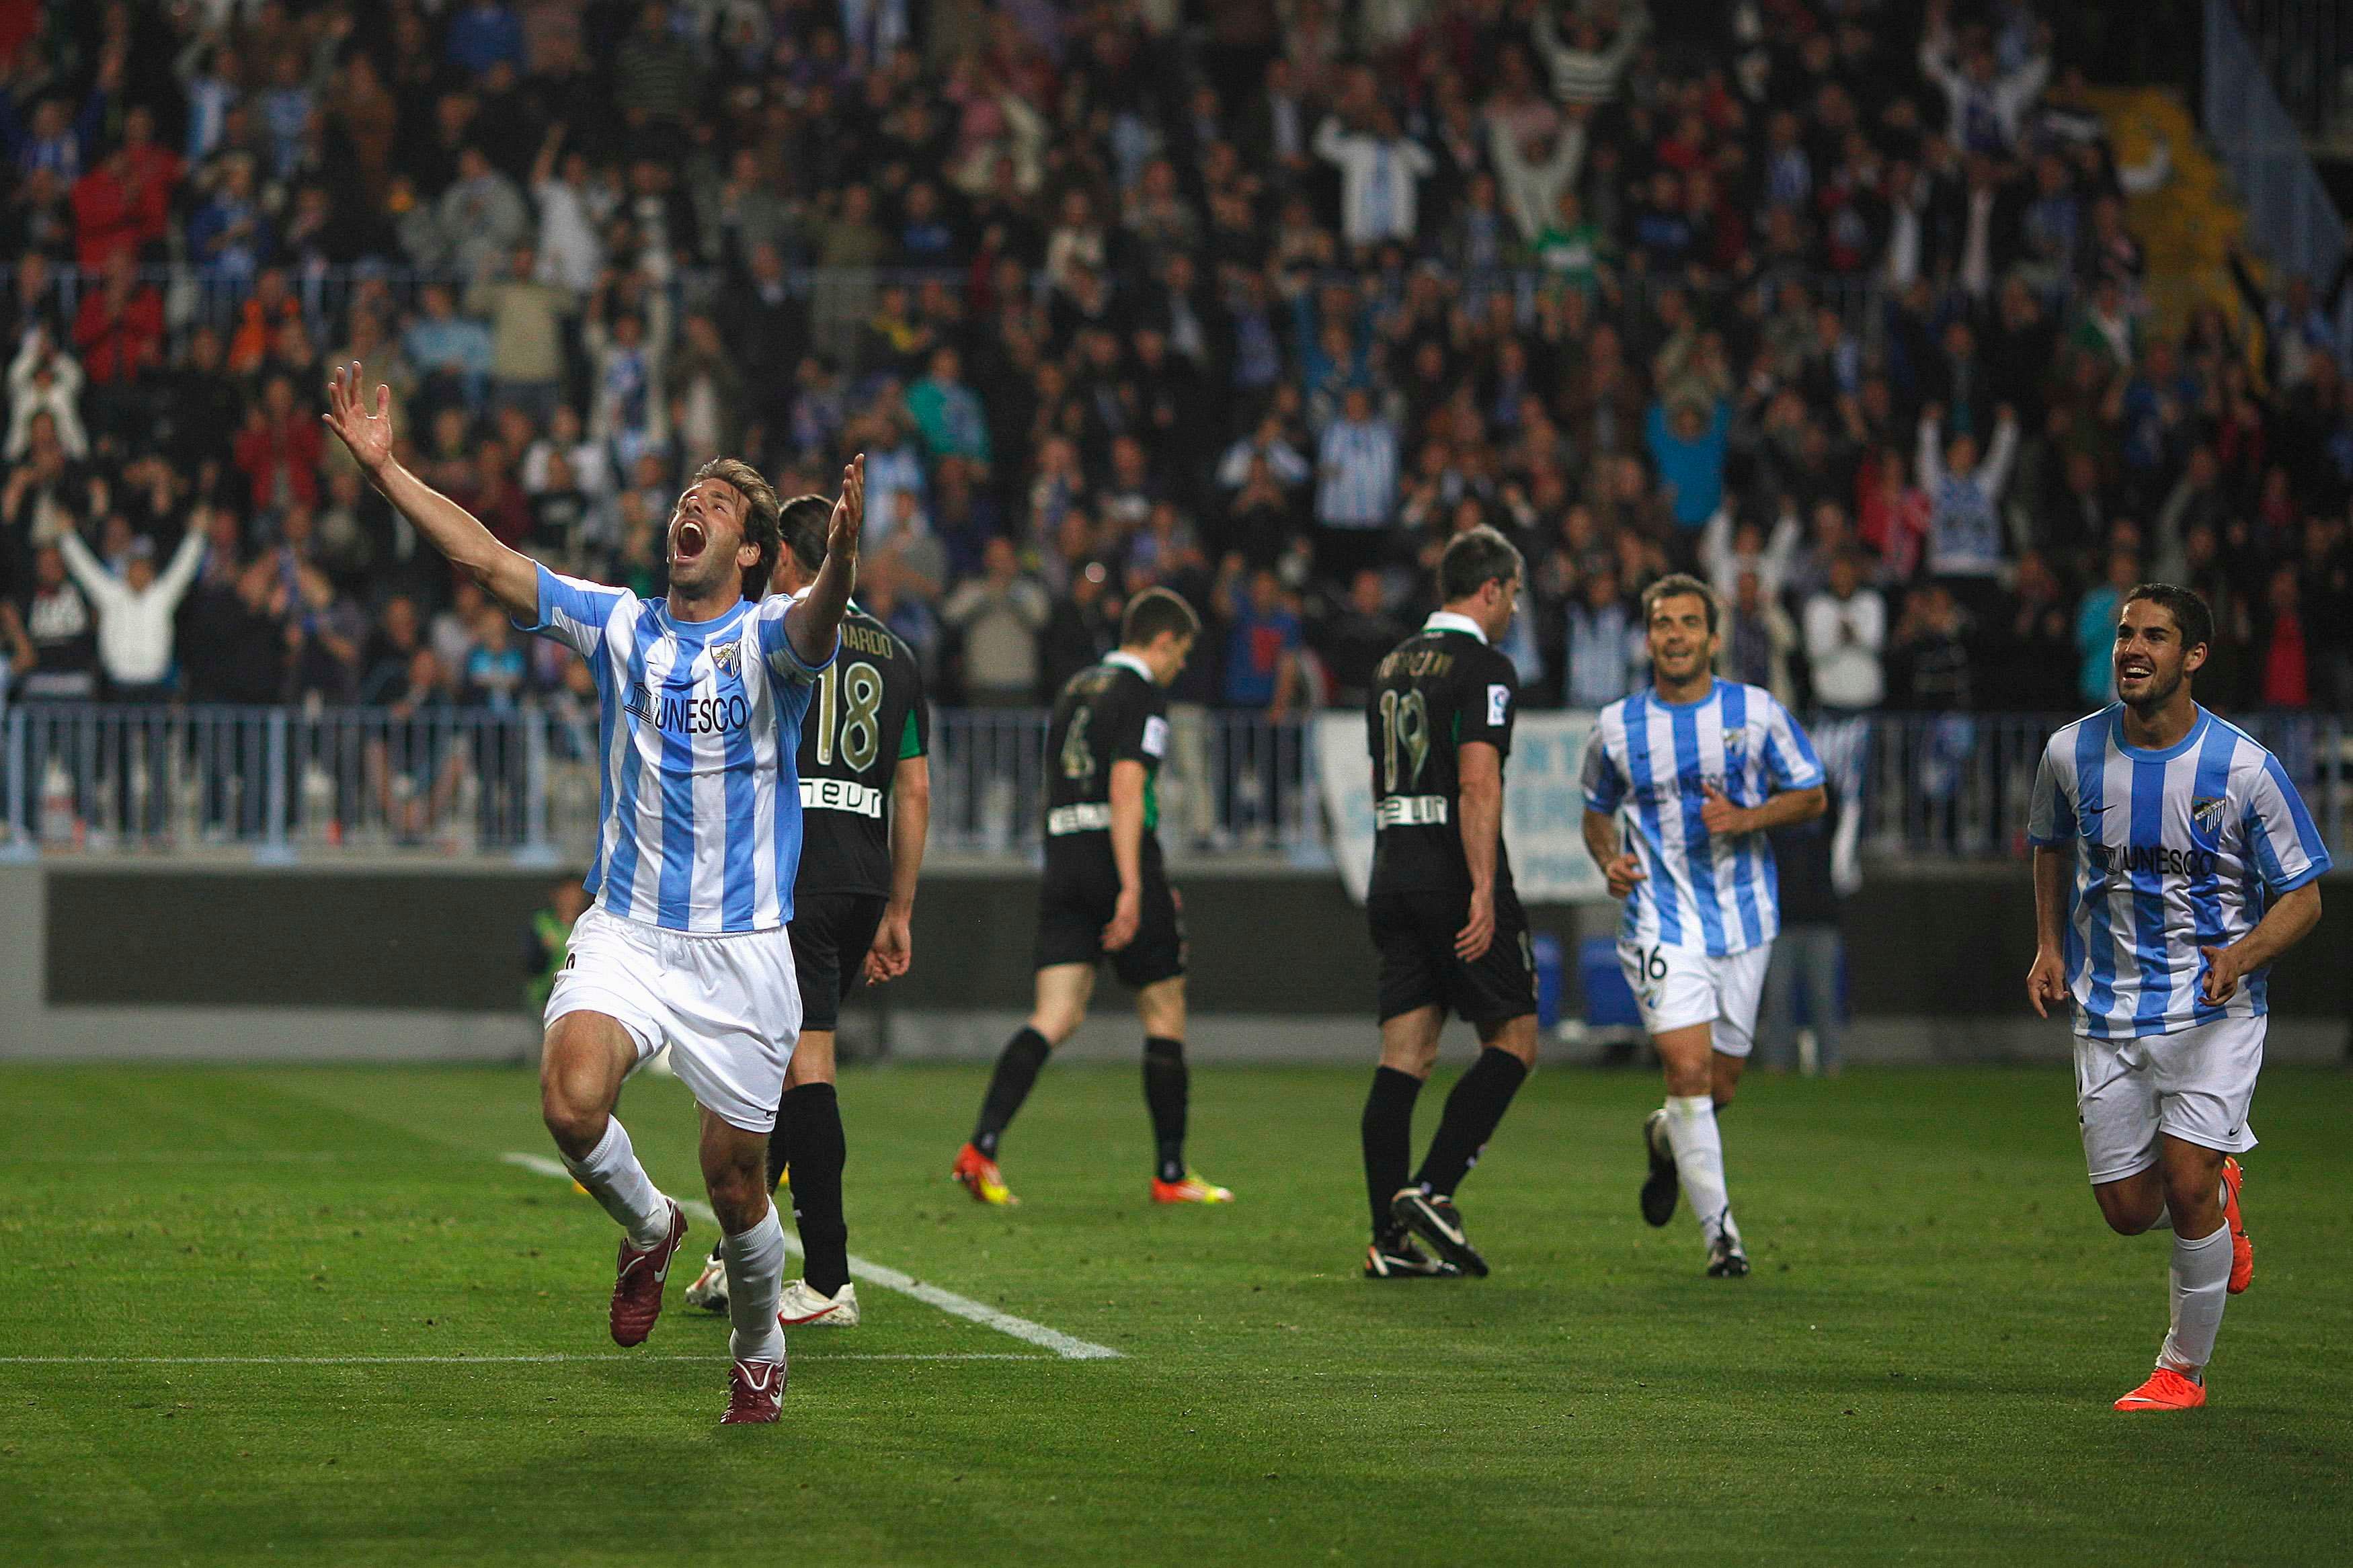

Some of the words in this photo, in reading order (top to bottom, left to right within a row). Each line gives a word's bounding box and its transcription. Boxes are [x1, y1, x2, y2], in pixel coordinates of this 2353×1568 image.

[655, 695, 747, 733] UNESCO
[817, 660, 883, 772] 18
[1380, 688, 1430, 793] 19
[2122, 844, 2215, 876] UNESCO
[1634, 944, 1667, 981] 16
